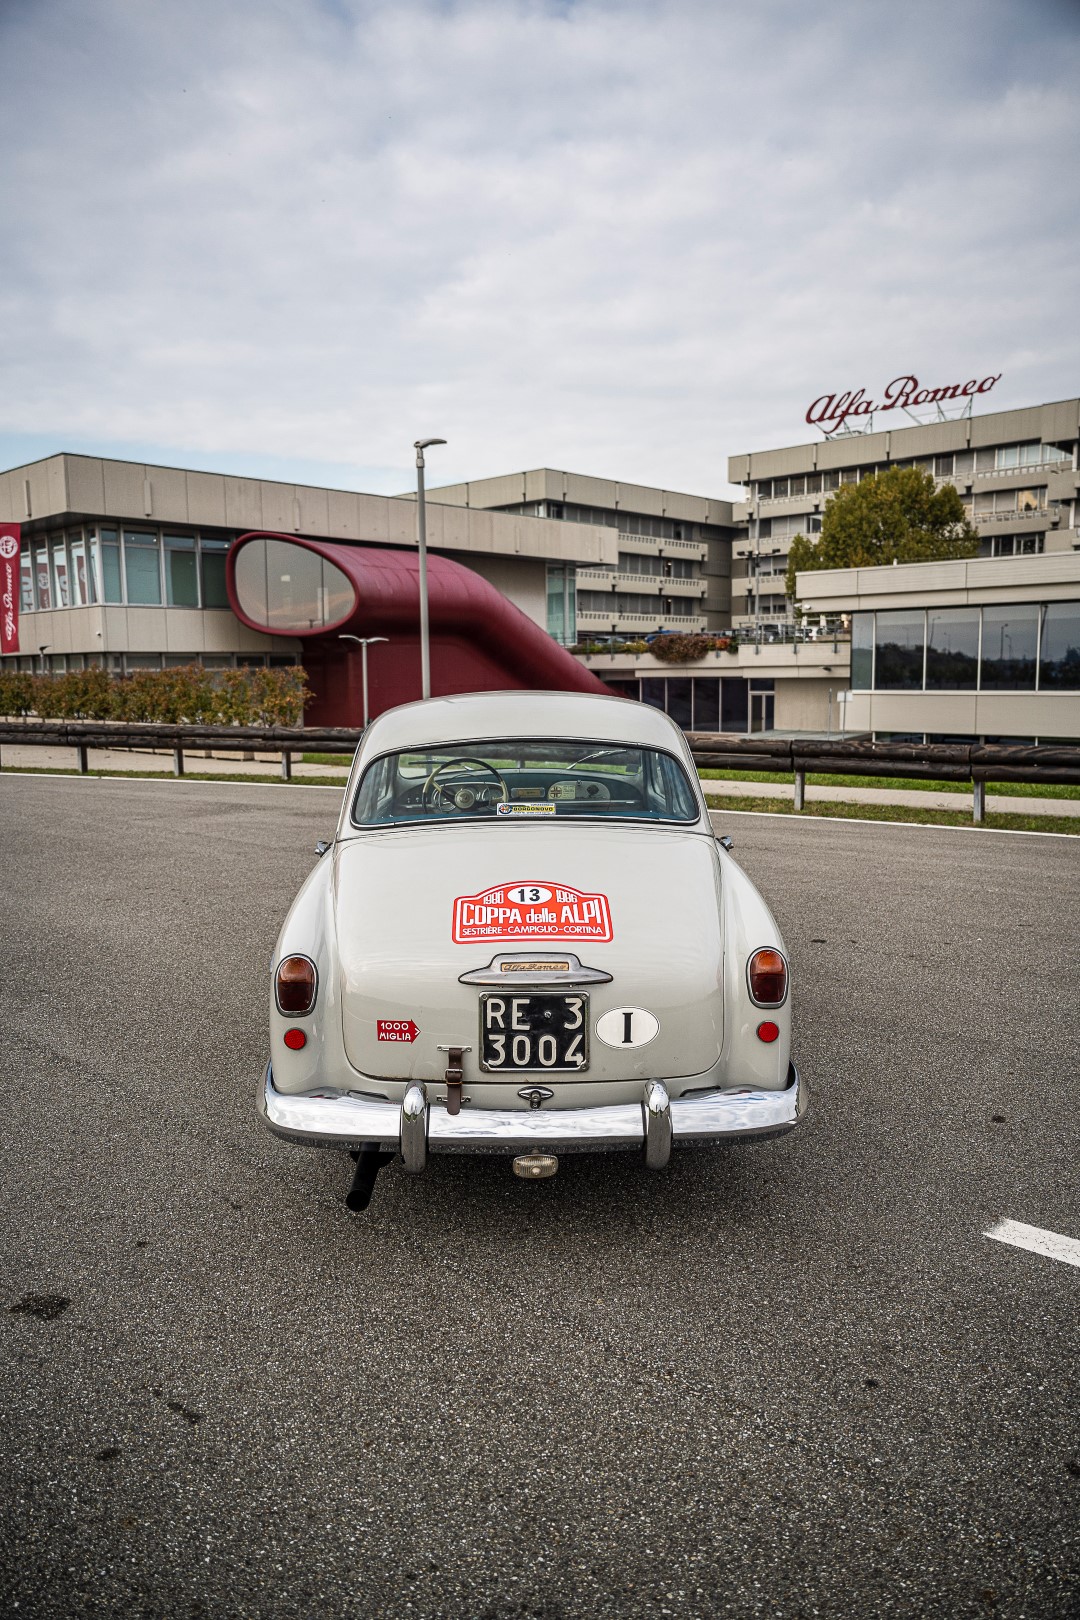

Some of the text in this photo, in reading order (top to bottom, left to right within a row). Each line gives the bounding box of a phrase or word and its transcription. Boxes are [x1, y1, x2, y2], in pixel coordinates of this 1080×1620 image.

[805, 374, 1003, 434] Alfa Romeo
[3, 563, 13, 609] Romeo
[5, 606, 17, 641] Alfa
[518, 888, 541, 902] 13
[555, 889, 578, 903] 1986
[462, 899, 602, 926] COPPA delle ALPI
[526, 963, 567, 971] Romeo
[380, 1021, 409, 1031] 1000
[486, 998, 583, 1031] RE 3
[621, 1012, 634, 1044] I
[379, 1032, 411, 1041] MIGLIA
[487, 1034, 583, 1066] 3004
